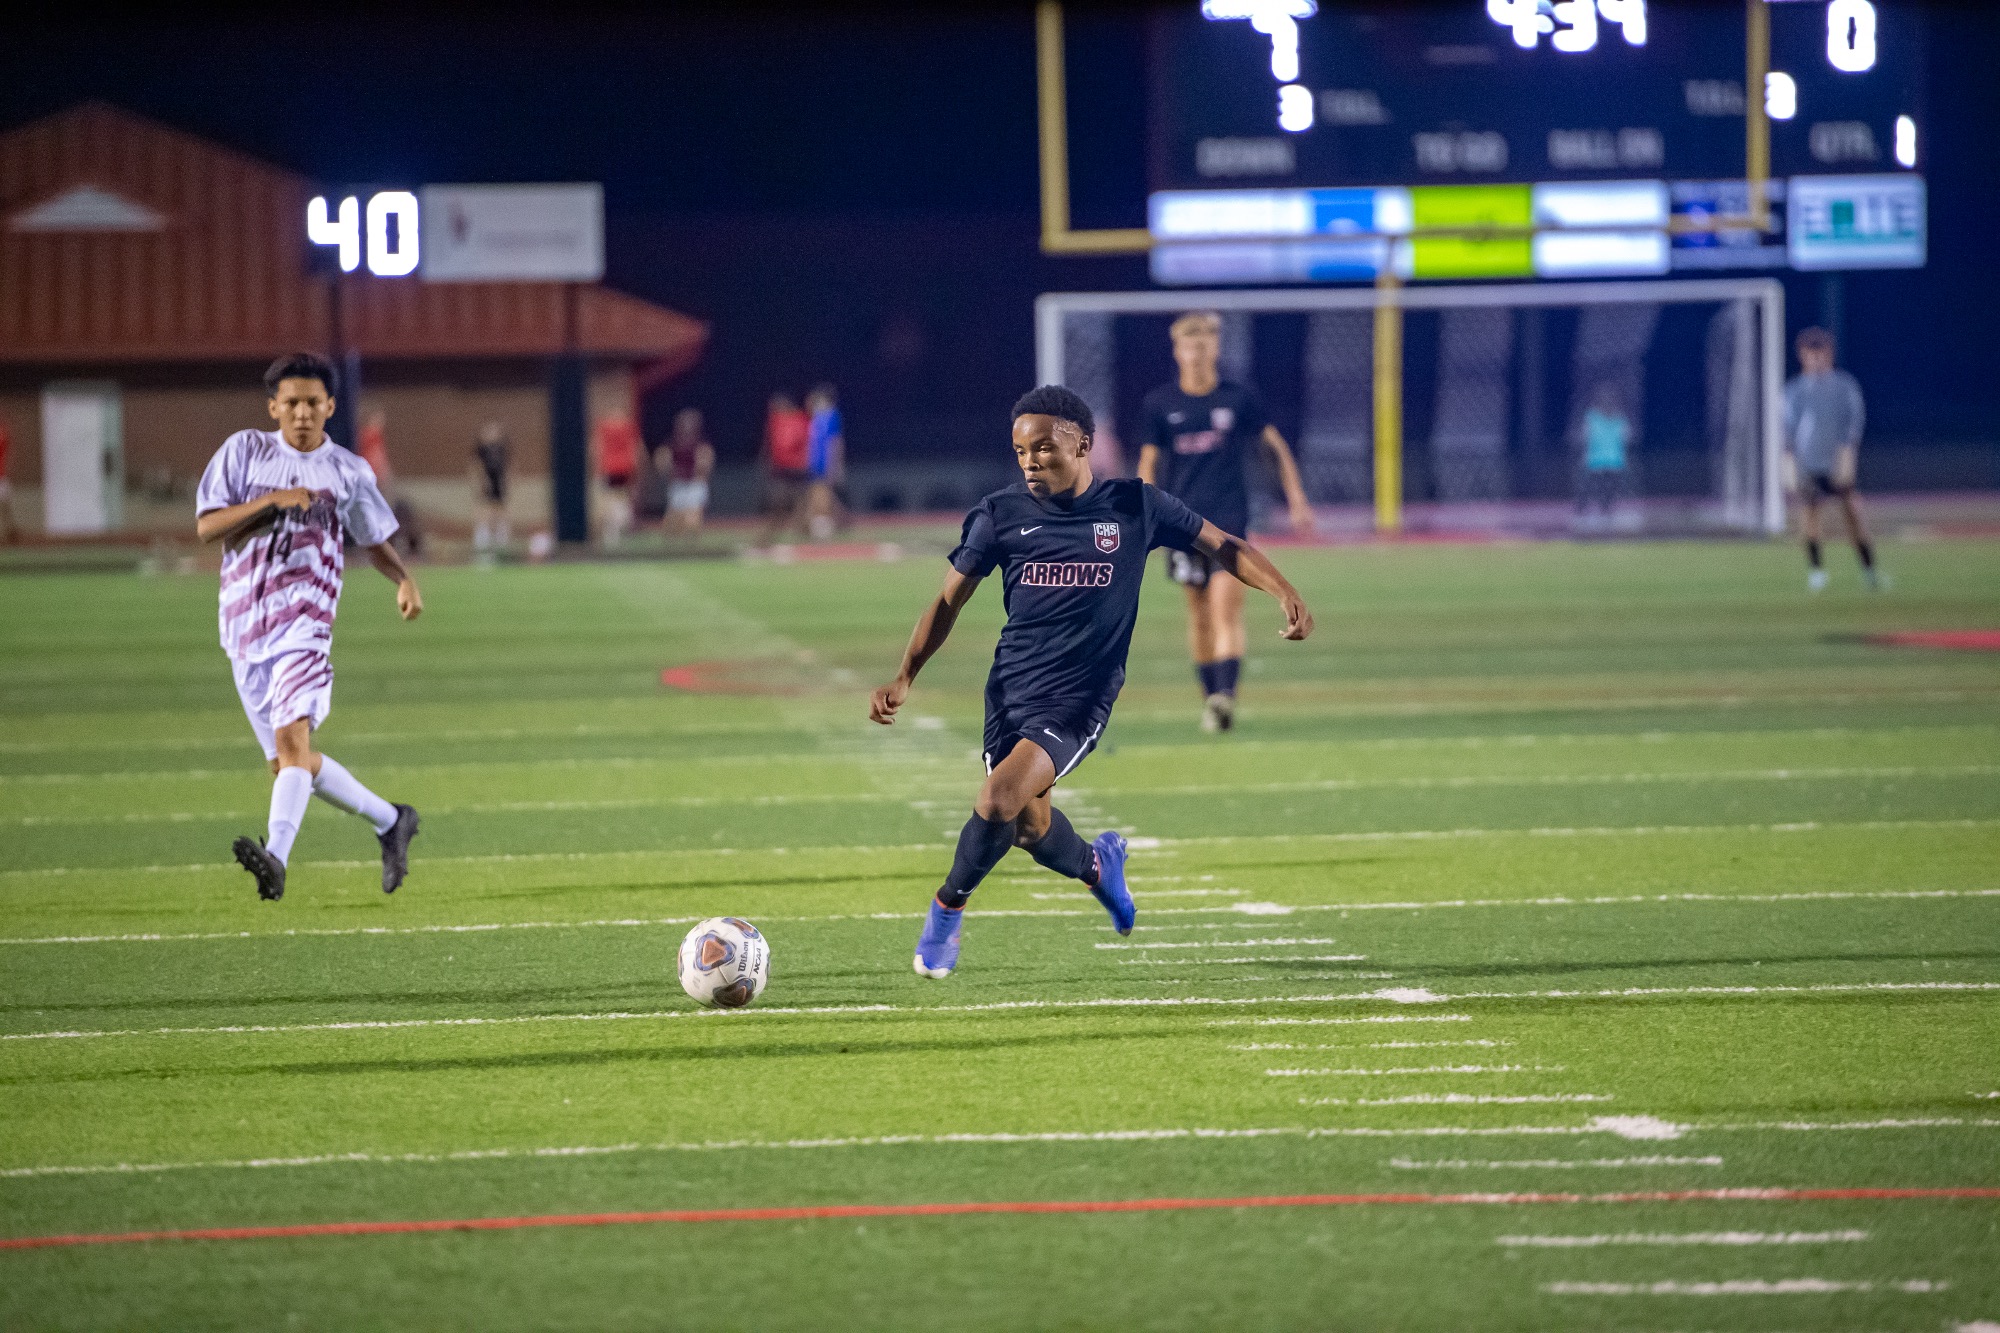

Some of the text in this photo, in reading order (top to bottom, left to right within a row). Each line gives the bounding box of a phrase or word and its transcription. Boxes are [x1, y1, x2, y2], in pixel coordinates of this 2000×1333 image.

[1827, 0, 1876, 71] 0
[307, 191, 420, 276] 40
[1095, 524, 1117, 537] CHS
[1021, 562, 1114, 587] ARROWS
[737, 941, 749, 972] Wilson
[753, 947, 762, 975] NCAA
